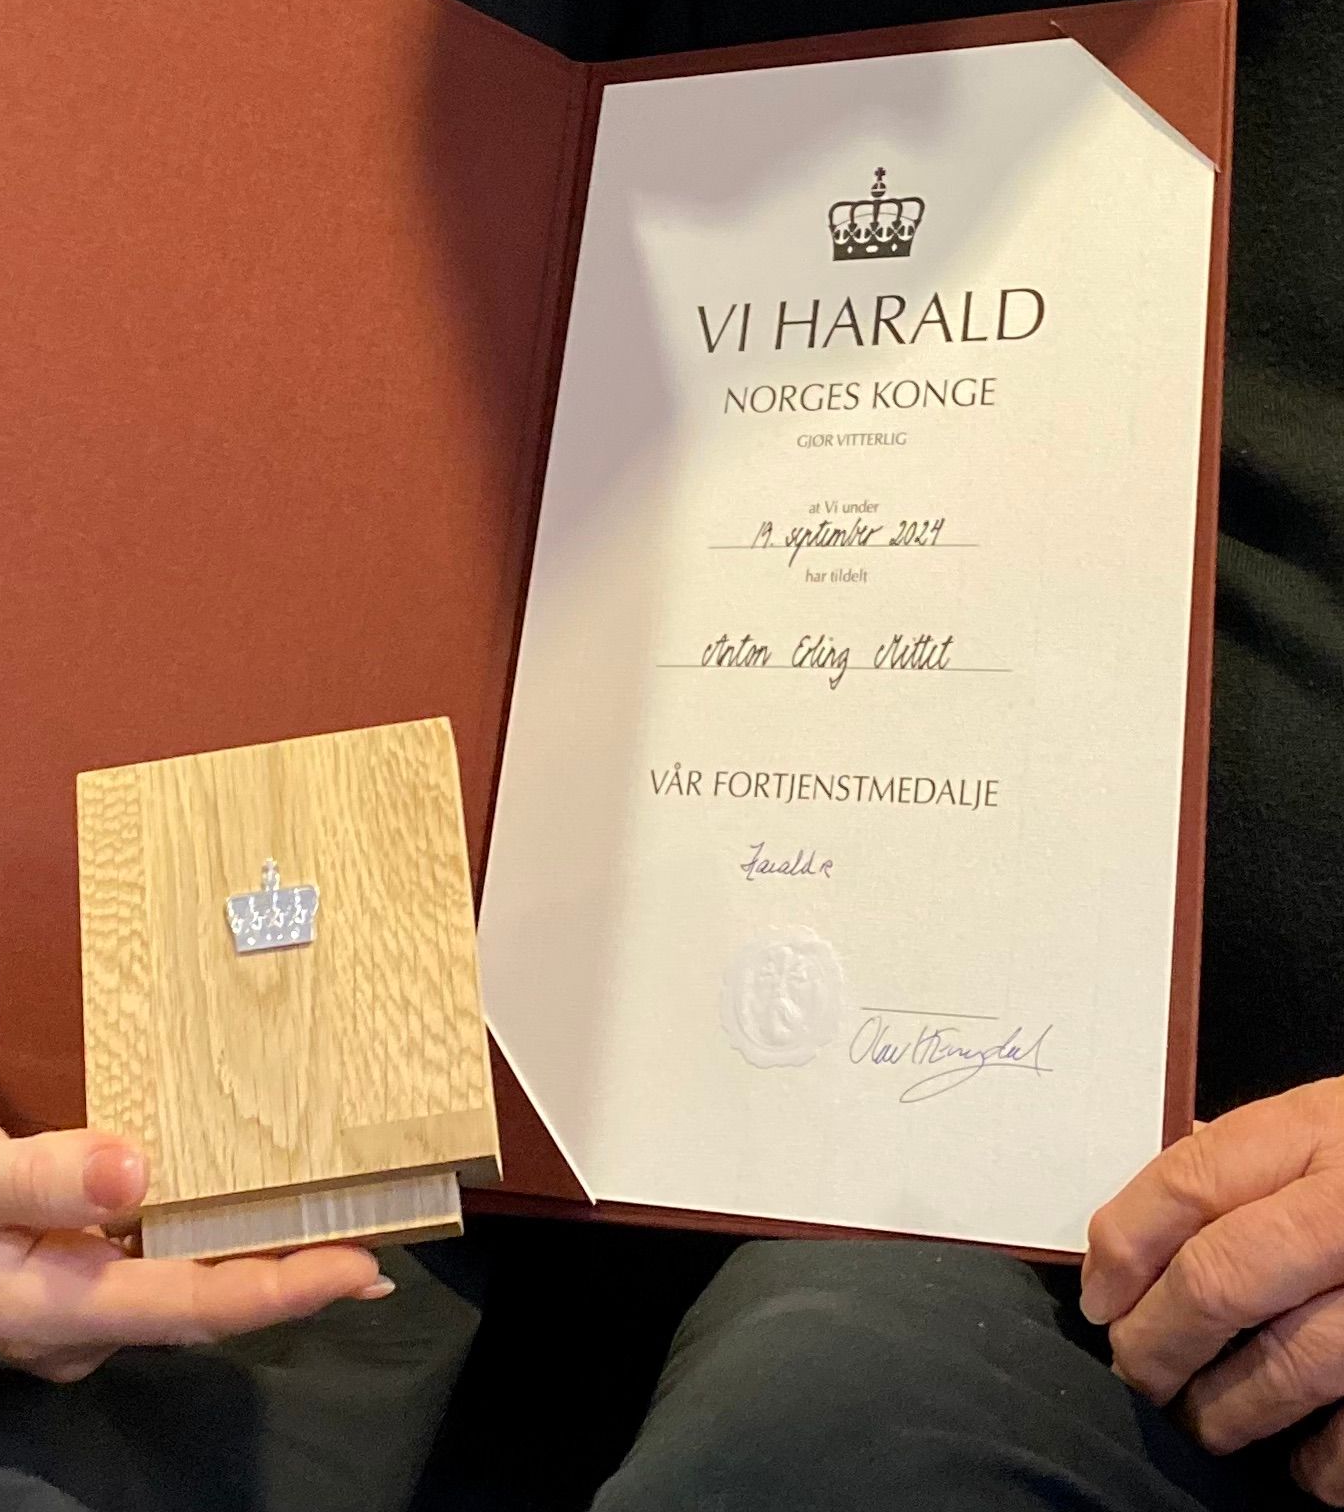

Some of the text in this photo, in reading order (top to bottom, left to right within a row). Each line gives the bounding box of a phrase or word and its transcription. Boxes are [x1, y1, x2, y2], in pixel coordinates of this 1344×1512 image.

[697, 287, 1046, 354] VI HARALD
[723, 378, 998, 414] NORGES KONGE
[836, 432, 908, 447] VITTERLIG
[808, 499, 880, 514] at Vi under
[785, 517, 884, 568] september
[888, 517, 946, 547] 2024
[805, 568, 868, 583] har tildelt
[701, 634, 773, 668] Anton
[873, 634, 955, 671] Mittet
[650, 761, 999, 811] VÅR FORTJENSTMEDALJE
